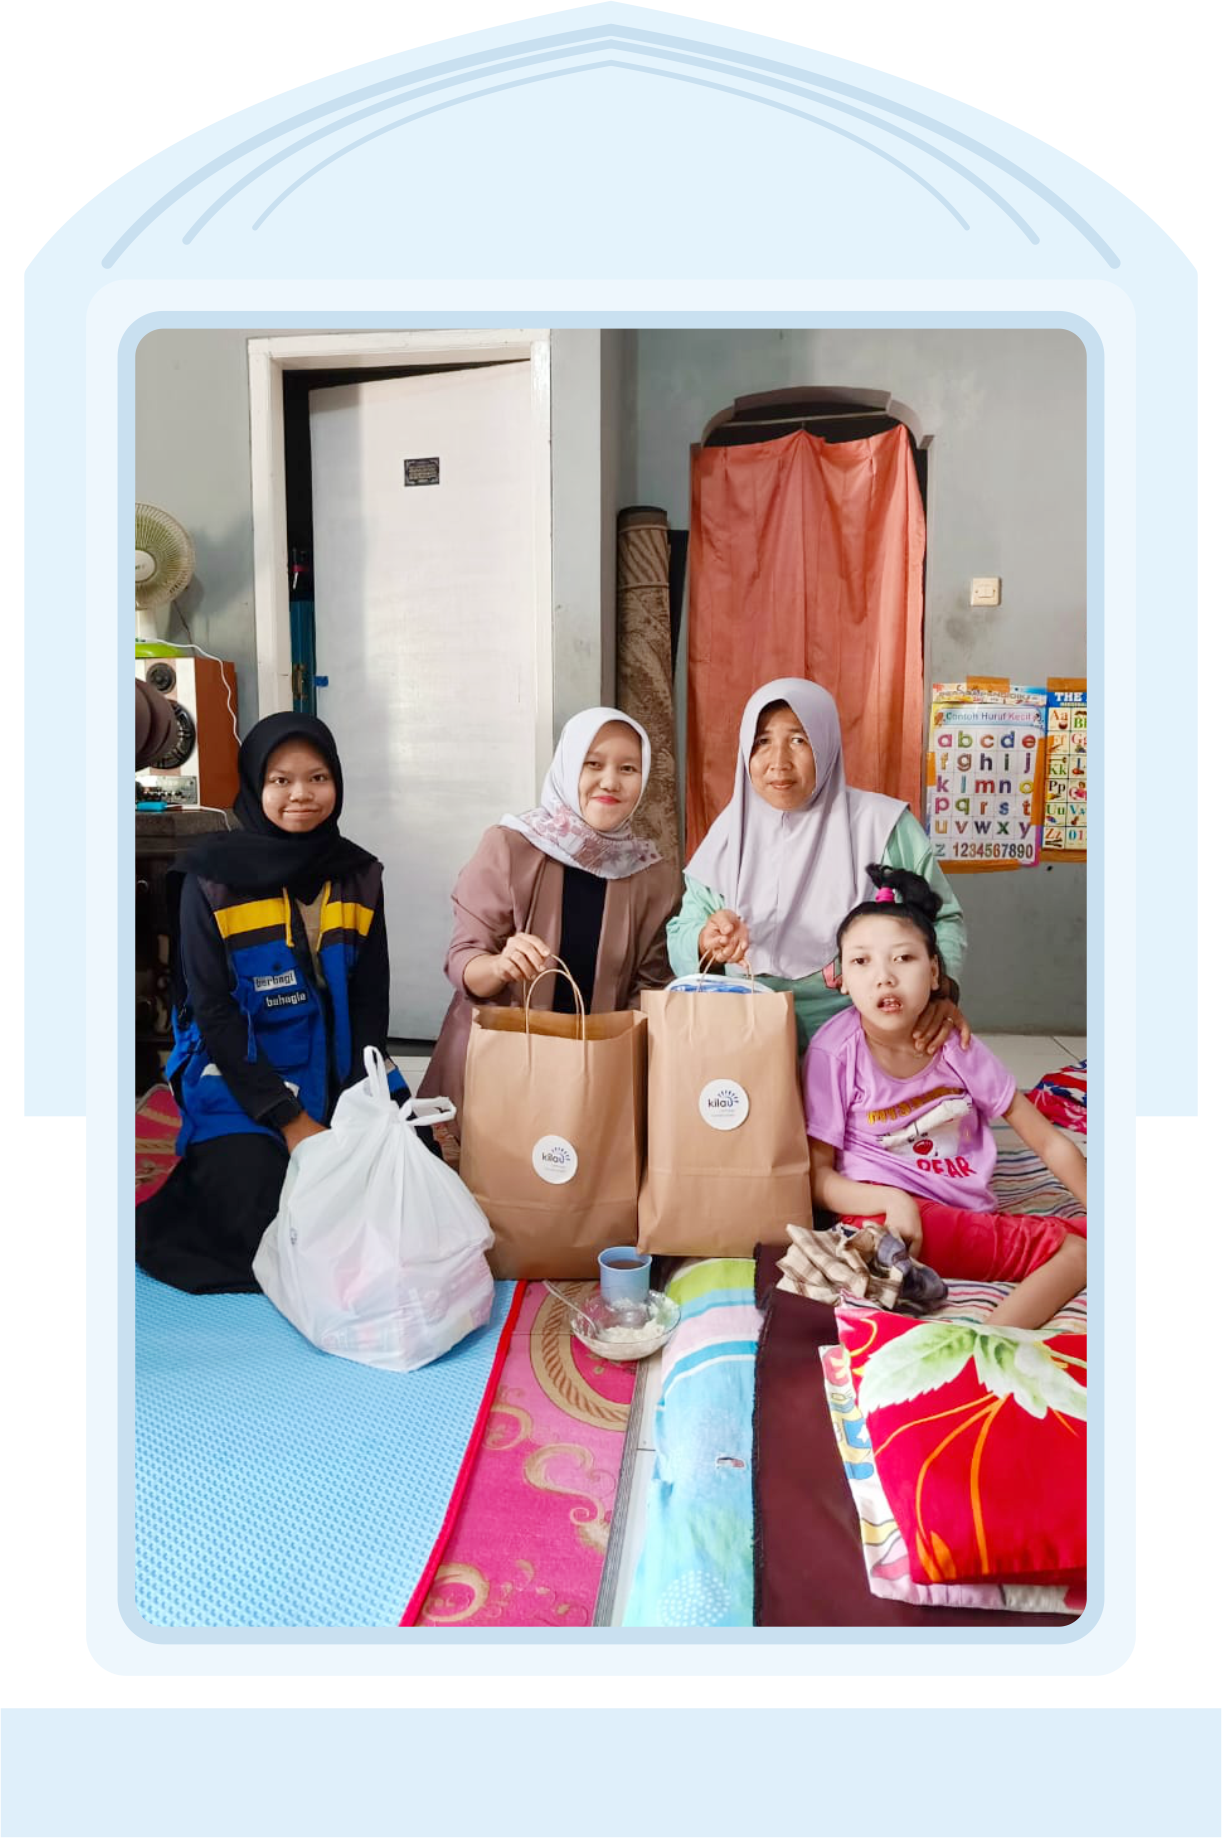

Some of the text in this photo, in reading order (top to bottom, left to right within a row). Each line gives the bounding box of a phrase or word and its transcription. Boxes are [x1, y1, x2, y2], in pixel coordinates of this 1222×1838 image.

[1054, 692, 1083, 702] THE
[946, 711, 1032, 721] Contoh Huruf Kecil
[938, 731, 1036, 748] a b c d e
[940, 753, 1031, 773] f g h i j
[937, 776, 949, 793] k
[975, 779, 995, 793] m
[1000, 779, 1011, 793] n
[1020, 780, 1033, 793] o
[935, 797, 1030, 815] p q r s t
[935, 821, 1031, 839] u v w x y
[953, 843, 1033, 858] 1234567890
